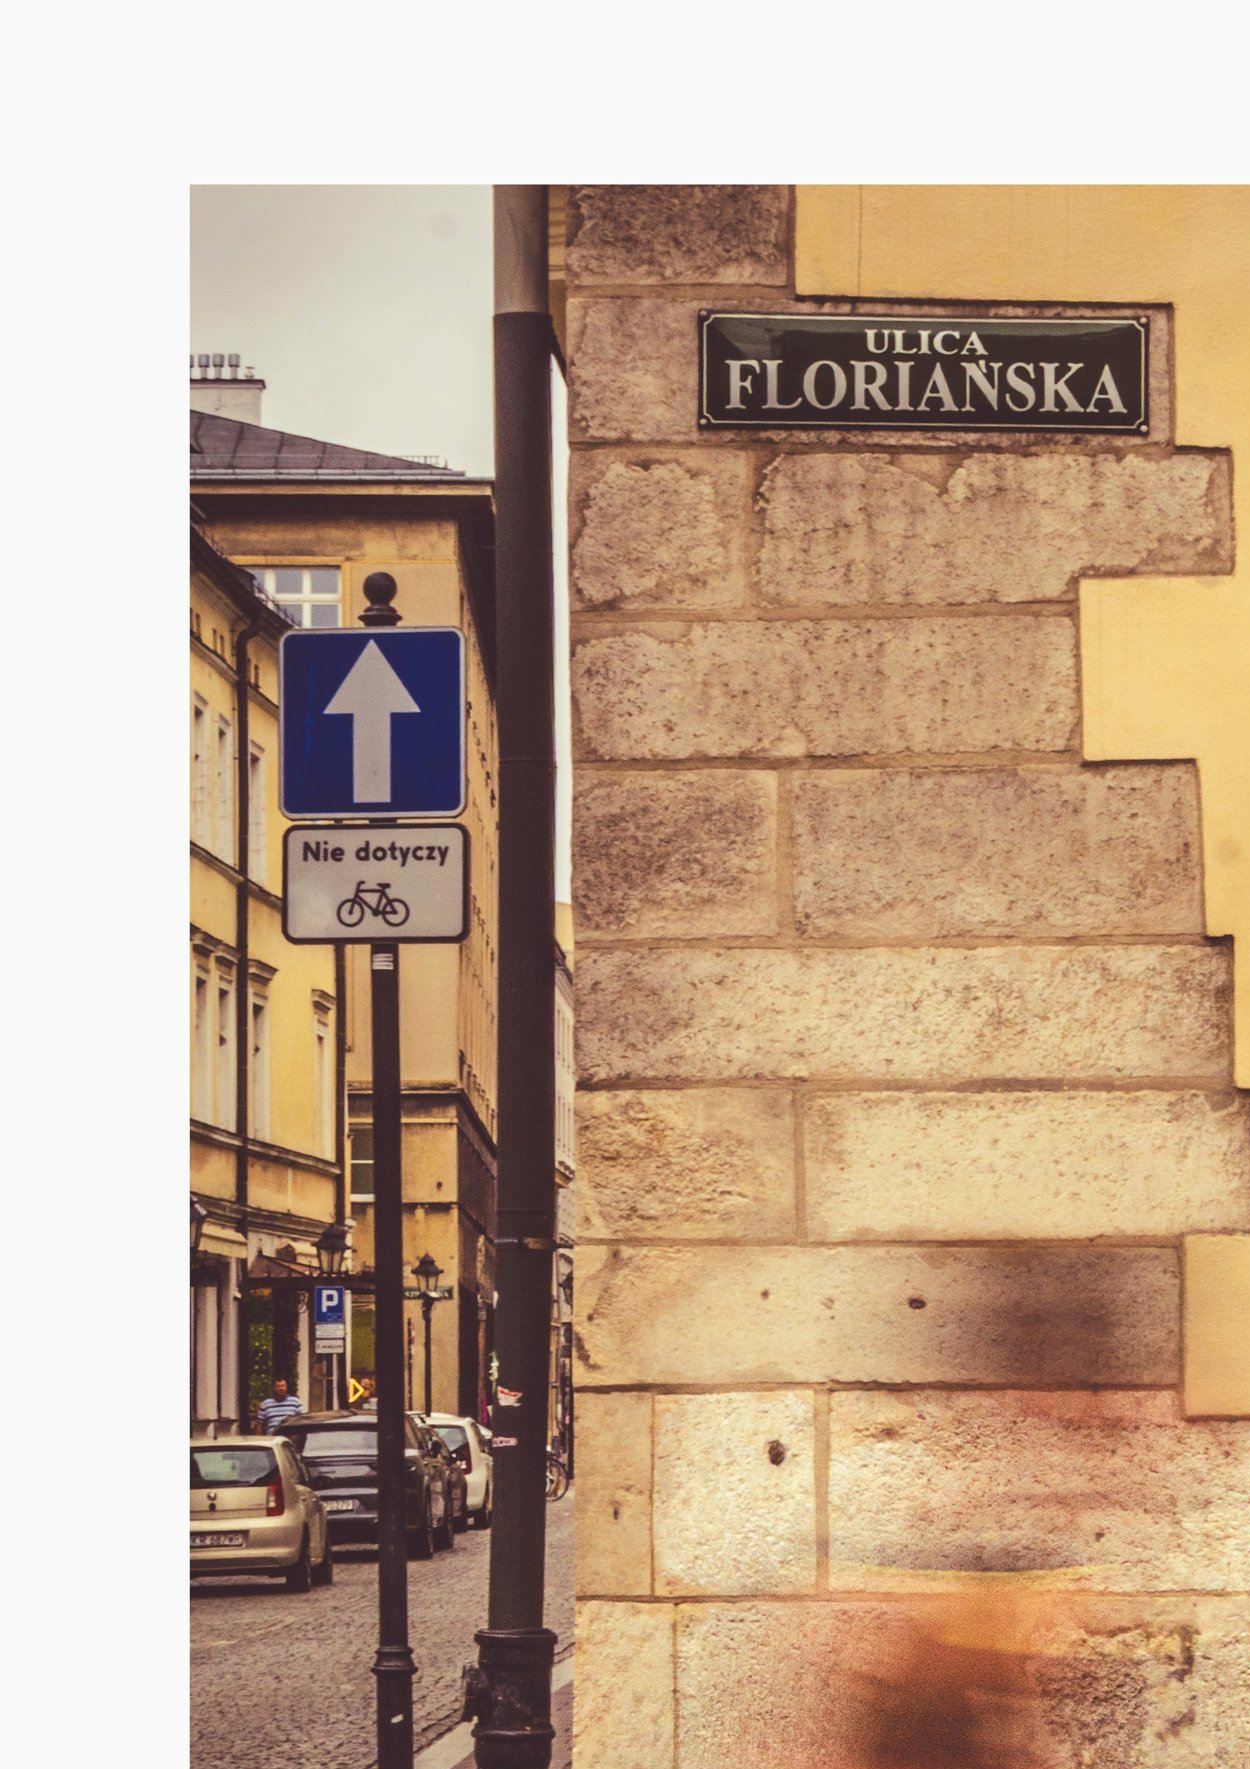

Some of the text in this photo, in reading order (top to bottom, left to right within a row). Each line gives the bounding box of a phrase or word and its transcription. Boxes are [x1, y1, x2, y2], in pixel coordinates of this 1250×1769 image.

[865, 329, 988, 356] ULICA
[724, 359, 1129, 414] FLORIAŃSKA
[302, 841, 449, 867] Nie dotyczy
[321, 1289, 339, 1313] P
